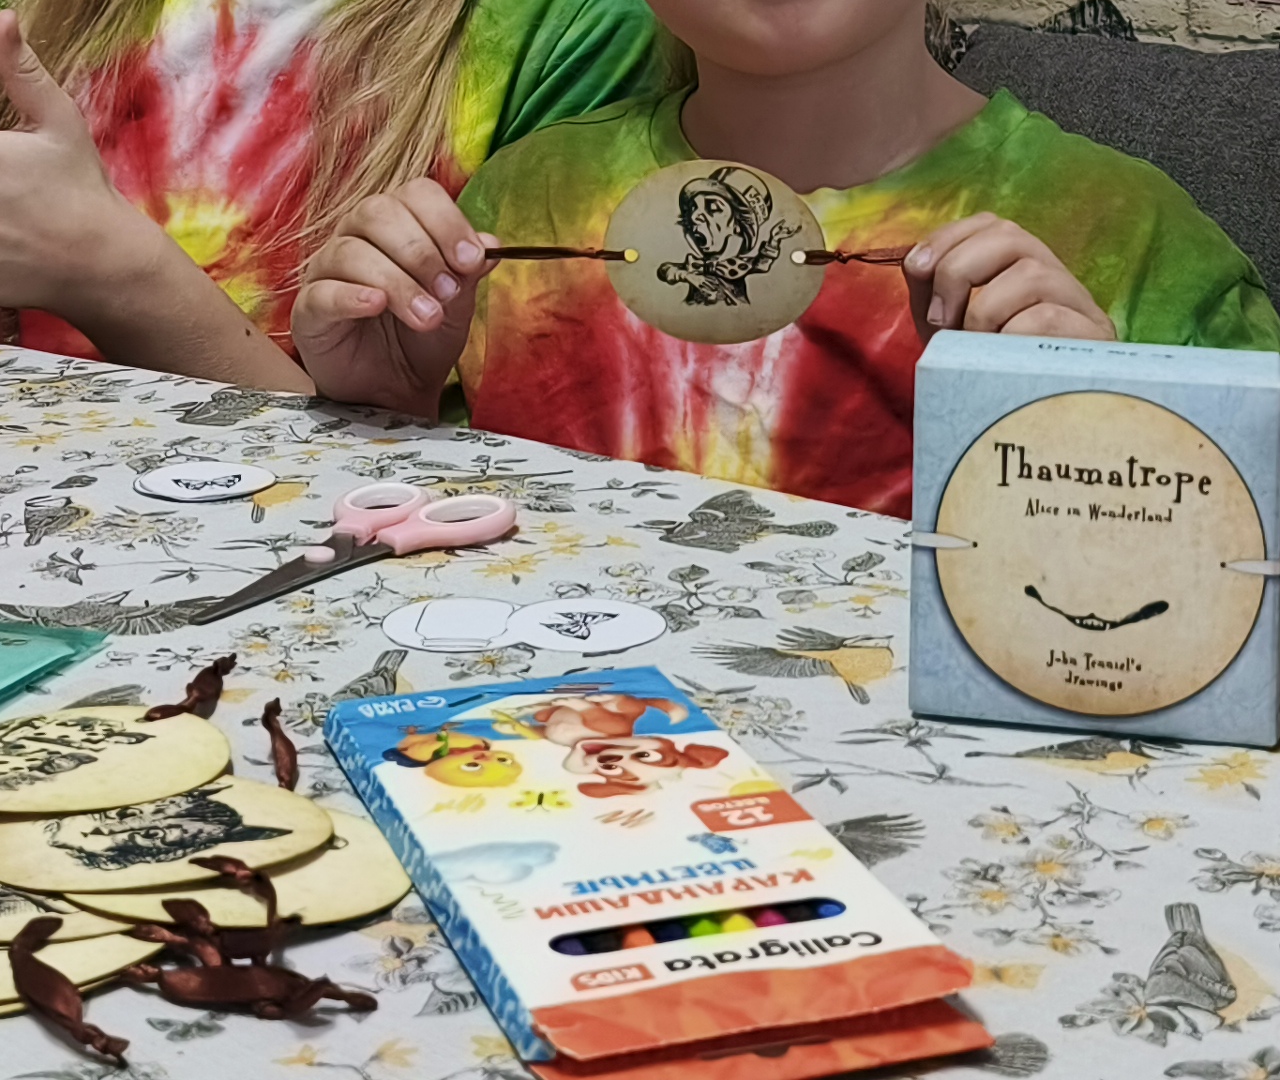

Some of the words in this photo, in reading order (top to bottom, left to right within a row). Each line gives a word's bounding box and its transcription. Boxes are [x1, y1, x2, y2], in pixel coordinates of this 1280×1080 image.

[994, 442, 1212, 504] Thaumatrope
[1025, 497, 1060, 517] Alice
[1067, 506, 1081, 517] in
[1088, 502, 1173, 523] Wonderland
[1046, 649, 1077, 668] John
[1083, 652, 1142, 672] Tenniel's
[719, 806, 775, 826] 12
[564, 858, 758, 896] ЦВЕТНЫЕ
[534, 868, 815, 920] КАРАНДАШИ
[664, 930, 882, 972] Calligrata
[578, 967, 643, 987] KIDS
